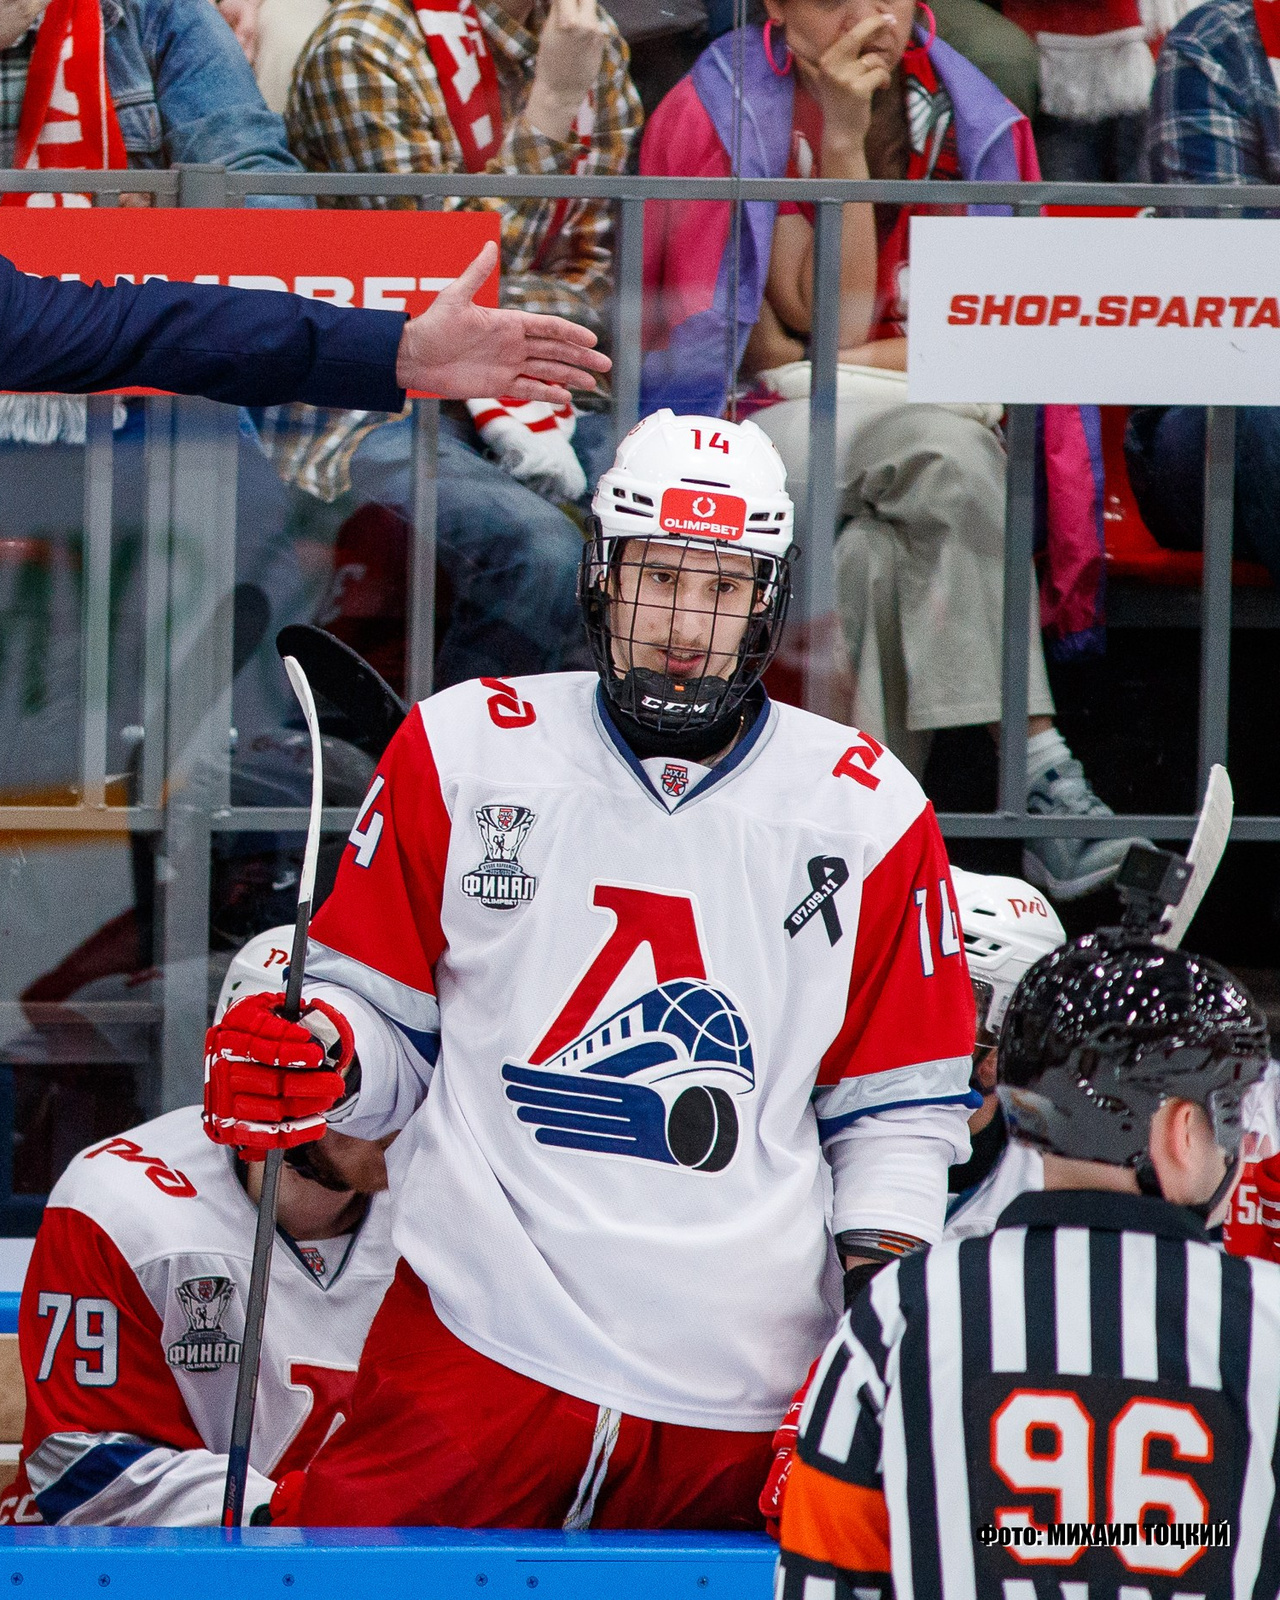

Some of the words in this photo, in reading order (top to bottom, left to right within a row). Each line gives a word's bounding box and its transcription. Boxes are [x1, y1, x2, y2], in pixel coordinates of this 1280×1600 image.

[690, 428, 730, 455] 14
[663, 517, 740, 537] OLIMPBET
[641, 695, 711, 714] CCM
[463, 875, 535, 900] ФИНАЛ
[790, 878, 839, 926] 07.09.11
[35, 1290, 119, 1388] 79
[169, 1342, 240, 1365] ФИНАЛ
[989, 1388, 1215, 1578] 96
